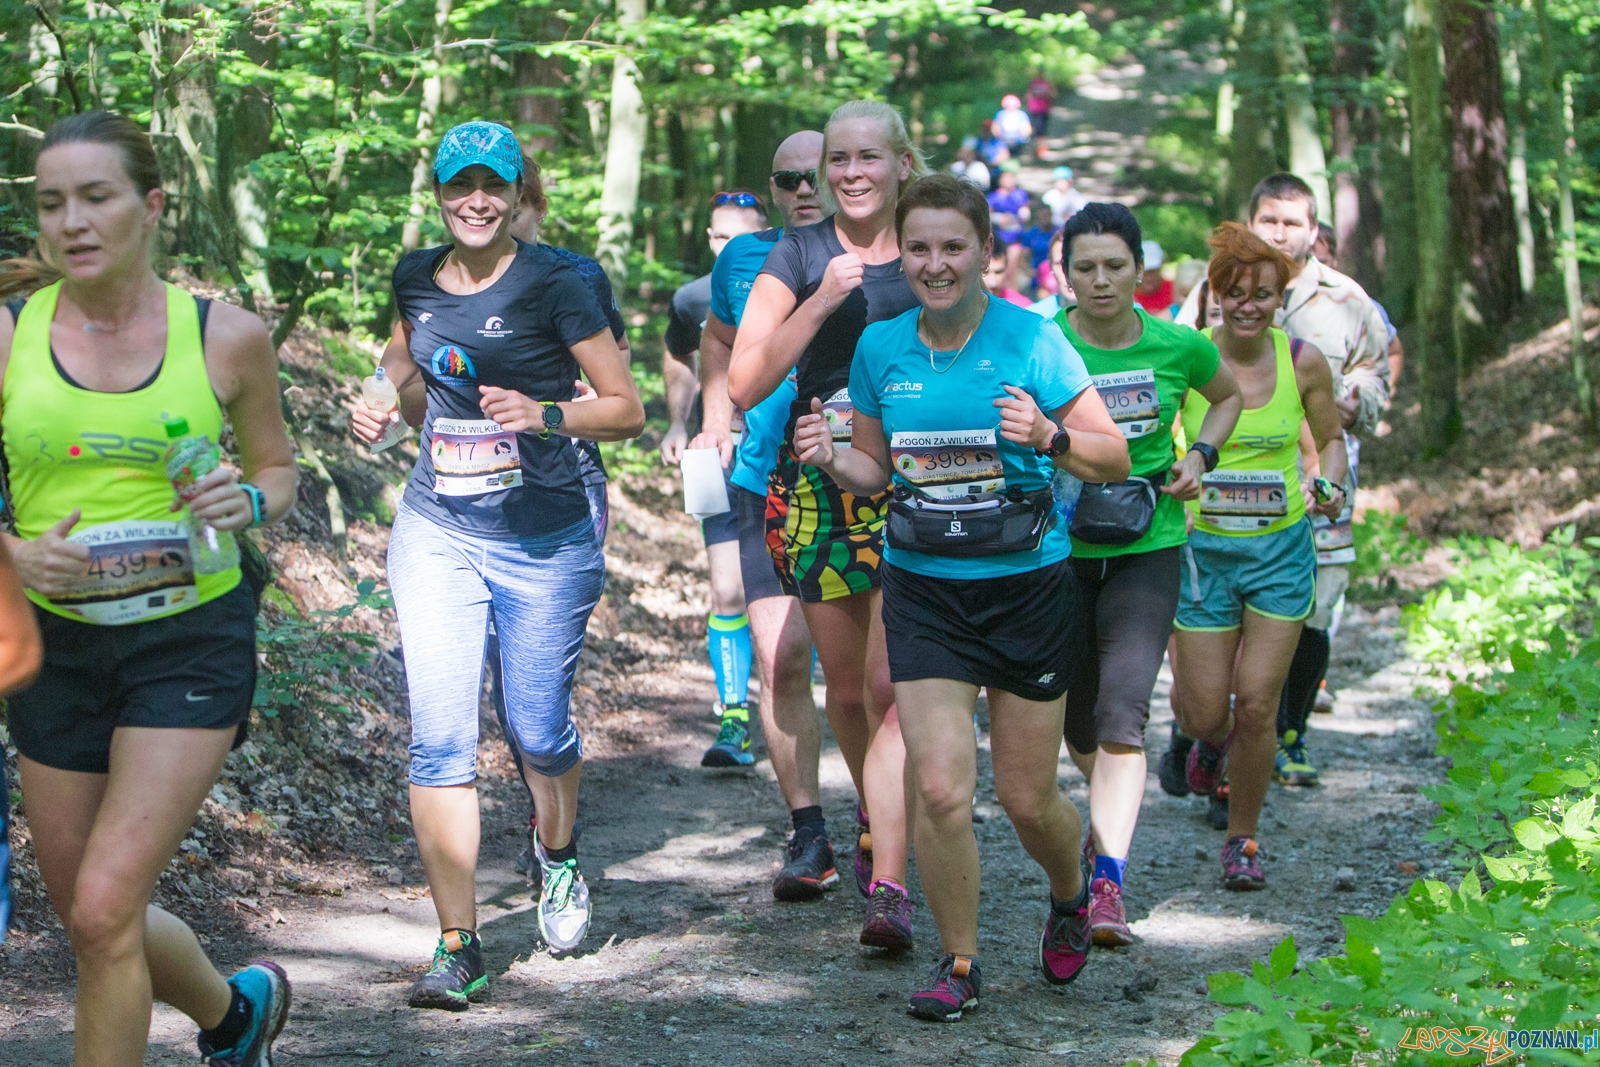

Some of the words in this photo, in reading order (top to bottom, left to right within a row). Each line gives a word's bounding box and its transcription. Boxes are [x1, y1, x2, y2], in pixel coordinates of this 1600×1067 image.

[1112, 375, 1148, 384] WILKIEM
[1104, 391, 1130, 409] 06
[439, 423, 456, 433] POGOŃ
[457, 425, 467, 433] ZA
[468, 424, 502, 433] WILKIE
[899, 435, 931, 446] POGOŃ
[933, 437, 945, 445] ZA
[947, 435, 988, 445] WILKIEM
[455, 441, 476, 460] 17
[923, 450, 967, 471] 398
[922, 472, 957, 480] CIASTOWICZ
[1226, 487, 1260, 503] 441
[104, 530, 122, 540] ZA
[124, 528, 178, 538] WILKIEM
[87, 547, 147, 580] 439
